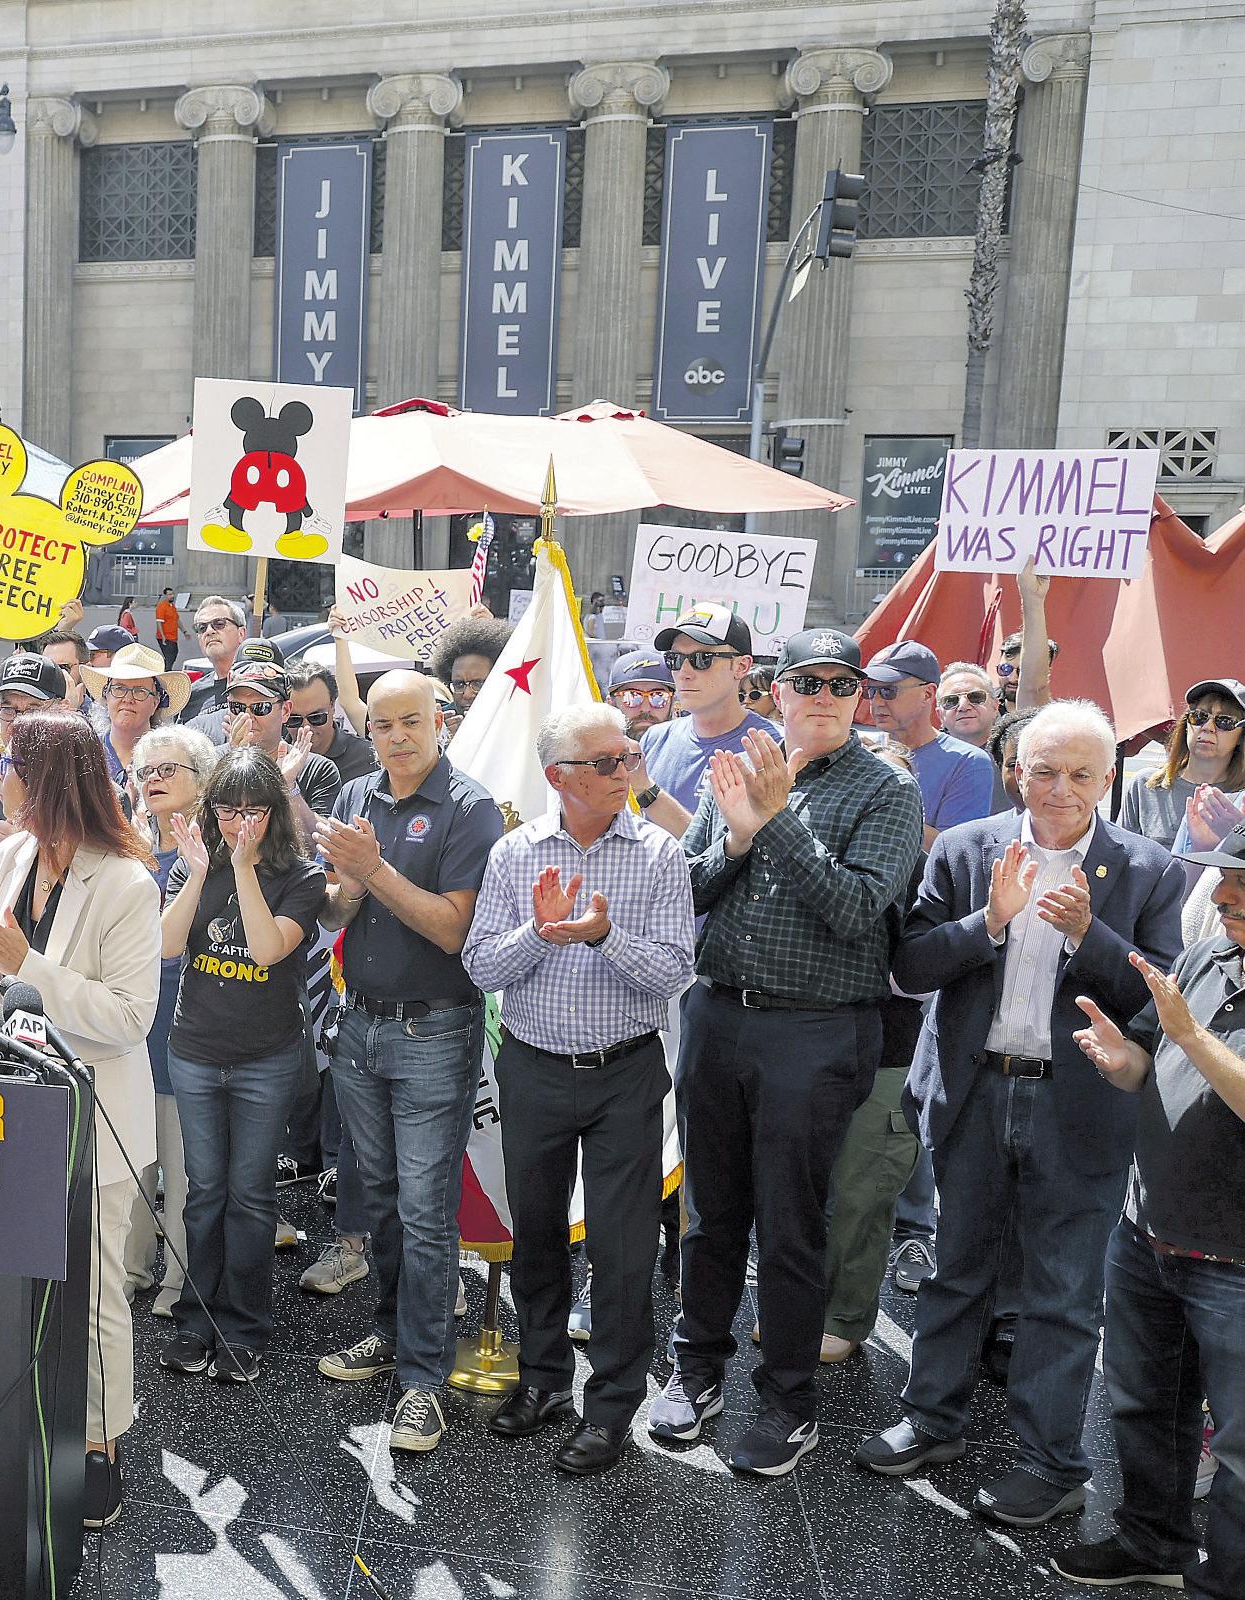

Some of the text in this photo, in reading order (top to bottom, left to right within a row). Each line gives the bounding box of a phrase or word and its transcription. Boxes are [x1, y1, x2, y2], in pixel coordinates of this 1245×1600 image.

[696, 169, 728, 333] LIVE
[303, 179, 338, 382] JIMMY
[491, 153, 529, 397] KIMMEL
[684, 365, 726, 385] abc
[866, 456, 945, 499] Kimmel
[876, 457, 908, 468] JIMMY
[75, 479, 135, 506] Disney CEO
[82, 470, 138, 496] COMPLAIN
[903, 486, 931, 495] LIVE!
[944, 453, 1150, 518] KIMMEL
[647, 535, 807, 589] GOODBYE
[946, 524, 1147, 571] WAS RIGHT
[346, 578, 379, 605] NO
[378, 591, 448, 640] PROTECT
[405, 613, 451, 646] FREE
[656, 592, 781, 636] HU
[192, 953, 269, 982] STRONG
[19, 1017, 44, 1033] AP
